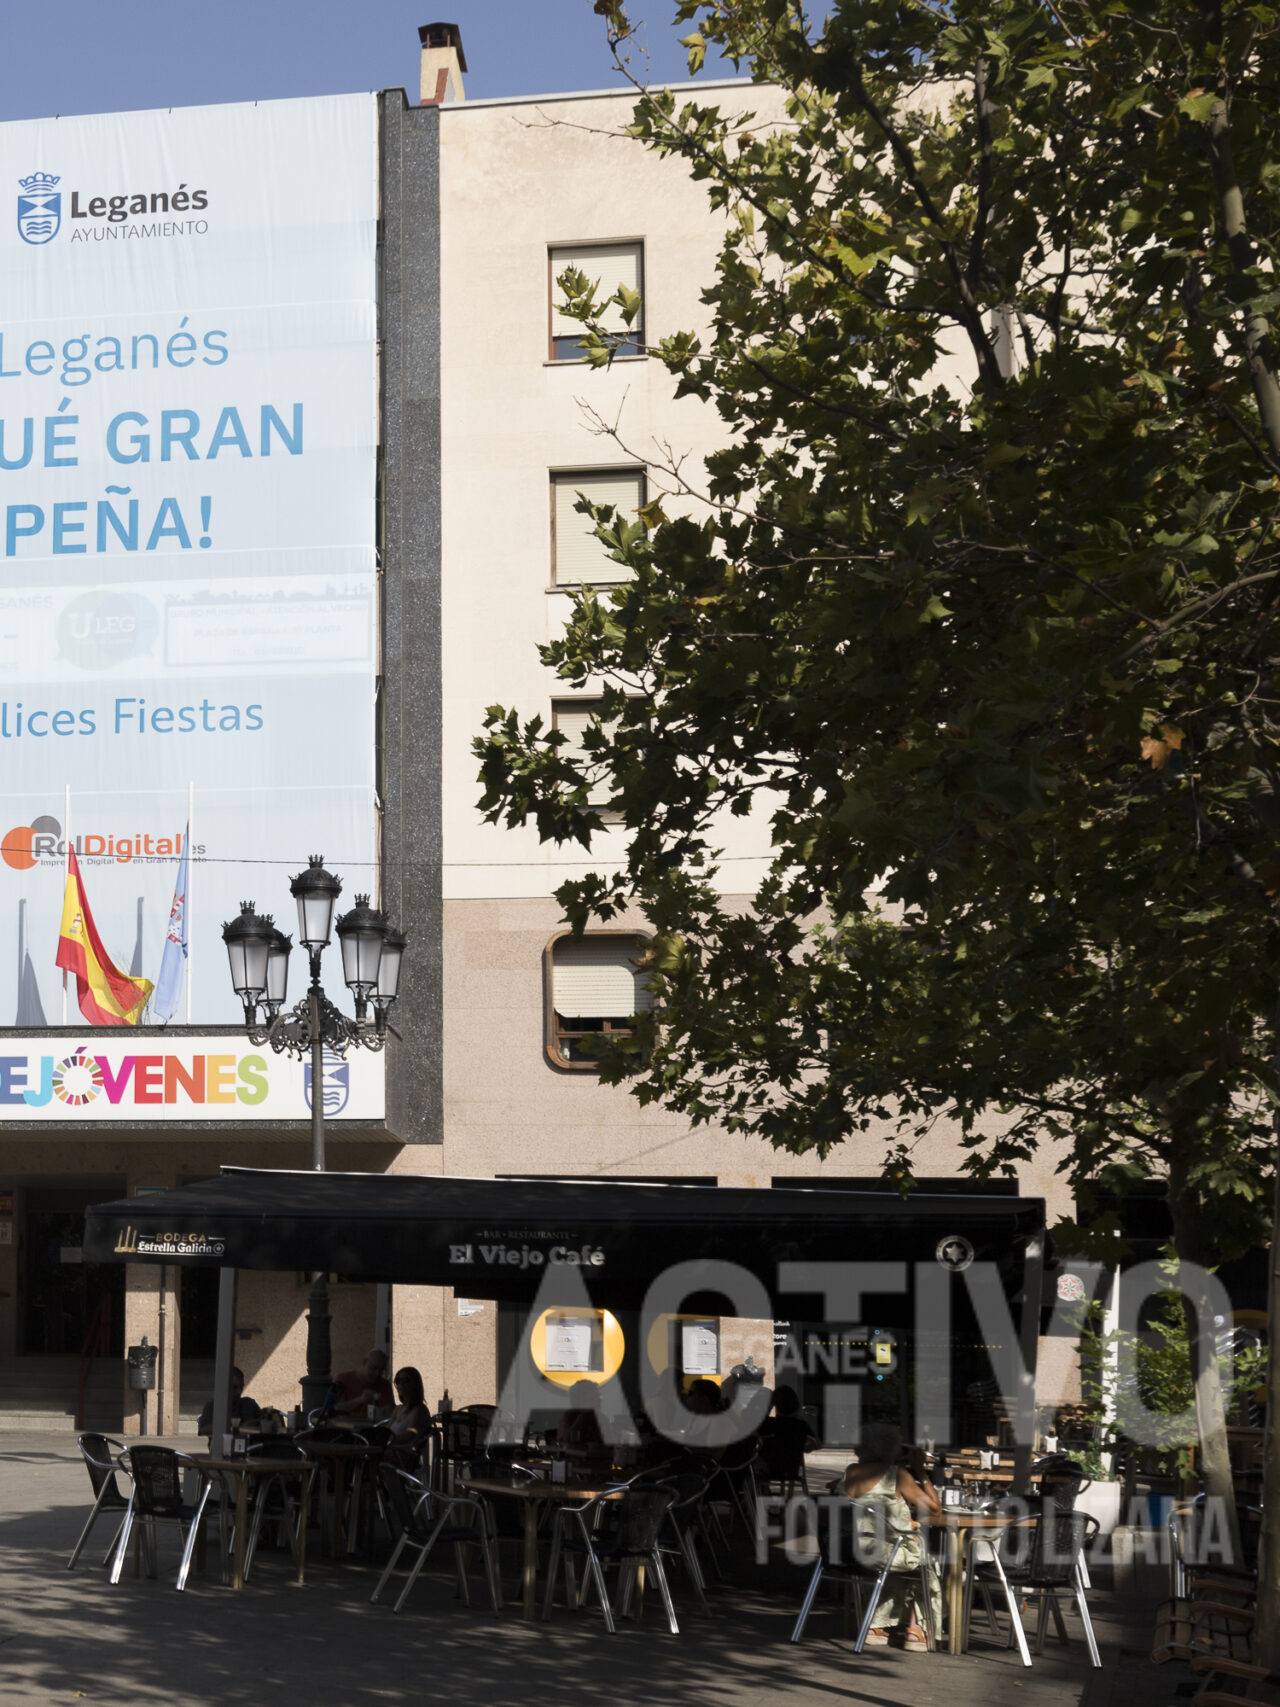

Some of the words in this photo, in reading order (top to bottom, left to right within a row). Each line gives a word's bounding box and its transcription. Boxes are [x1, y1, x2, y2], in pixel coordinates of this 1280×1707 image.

[70, 185, 209, 223] Leganés
[70, 219, 209, 243] AYUNTAMIENTO
[105, 402, 305, 464] GRAN
[5, 484, 214, 558] PEÑA!
[114, 697, 265, 735] Fiestas
[138, 1241, 175, 1253] Estrella
[177, 1242, 212, 1254] Galicia
[156, 1232, 207, 1242] BODEGA
[449, 1244, 474, 1264] El
[479, 1244, 544, 1270] Viejo
[549, 1244, 606, 1266] Café
